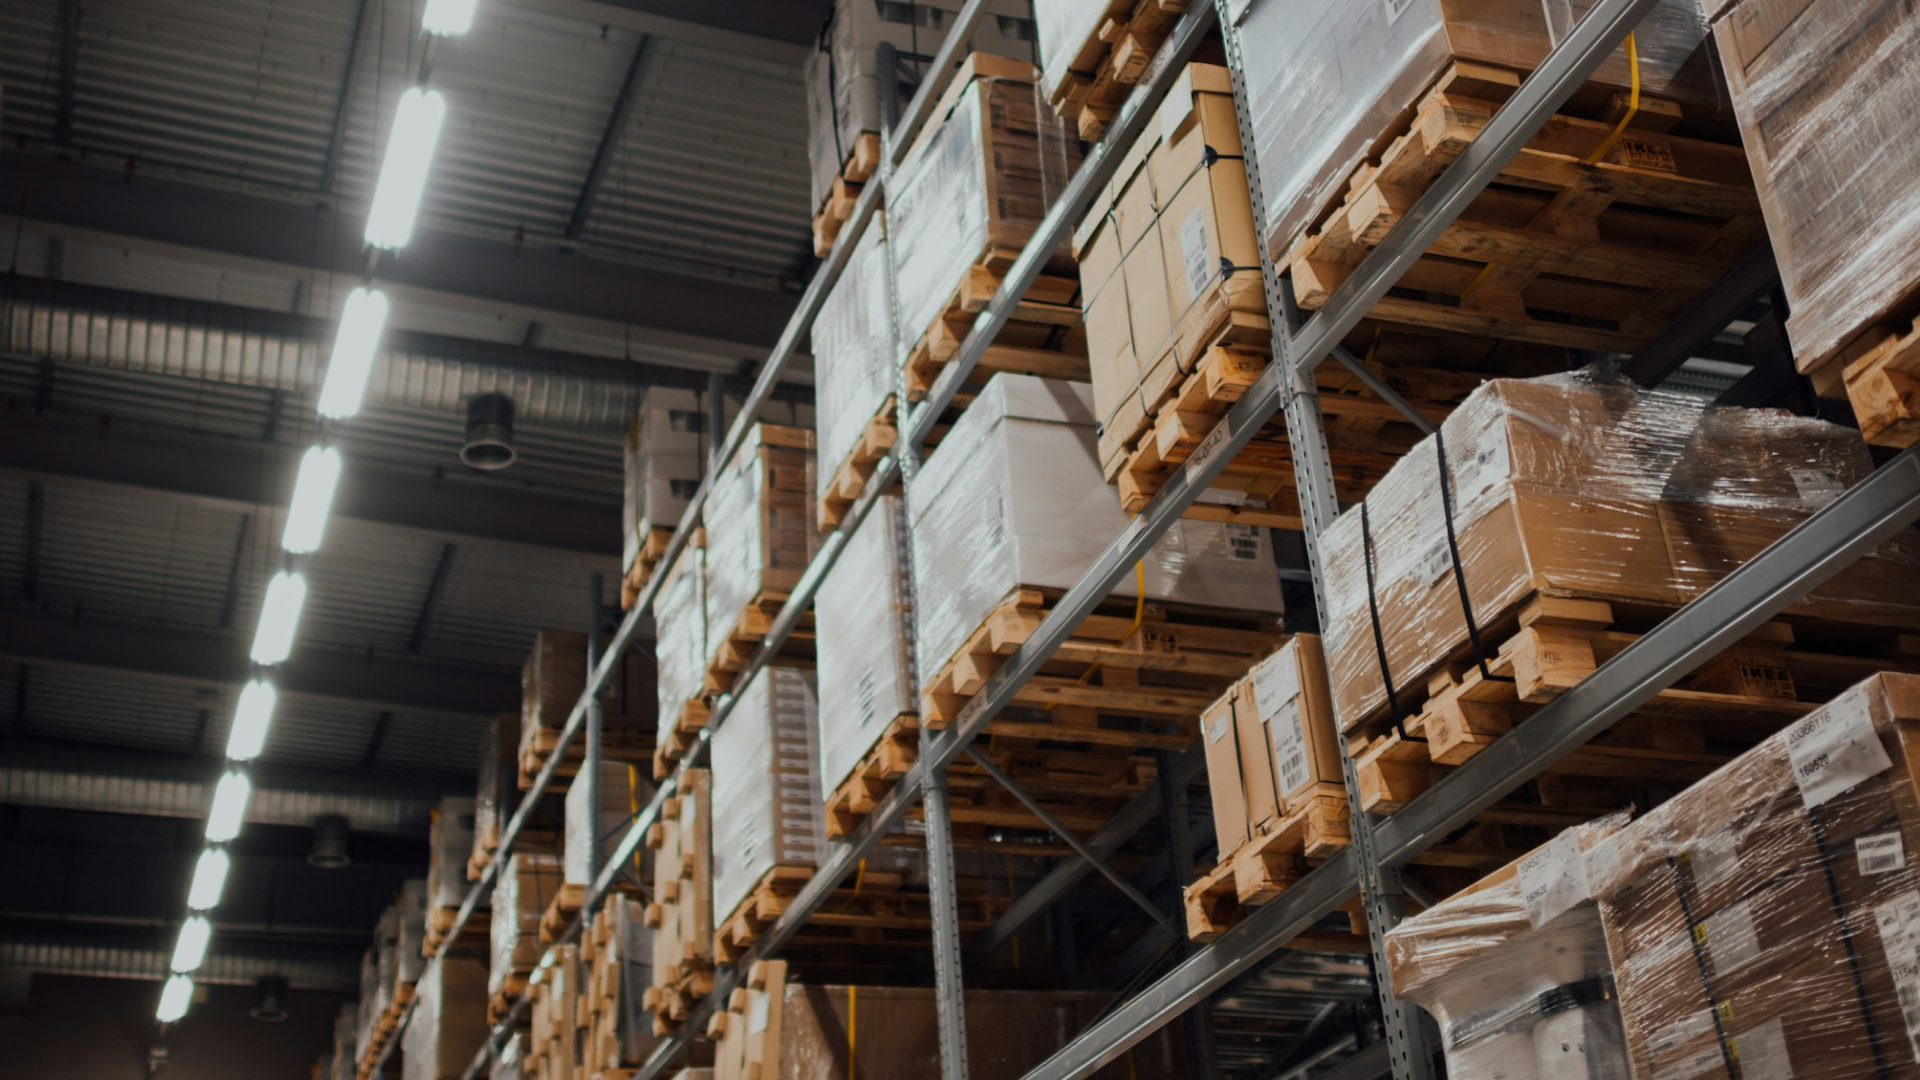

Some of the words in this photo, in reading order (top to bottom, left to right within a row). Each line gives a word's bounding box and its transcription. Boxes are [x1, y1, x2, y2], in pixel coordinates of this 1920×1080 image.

[1626, 141, 1669, 156] IKEA
[1742, 666, 1789, 681] IKEA
[1789, 711, 1831, 744] 20366116
[1799, 753, 1829, 778] 160520
[1893, 965, 1919, 982] 315kg
